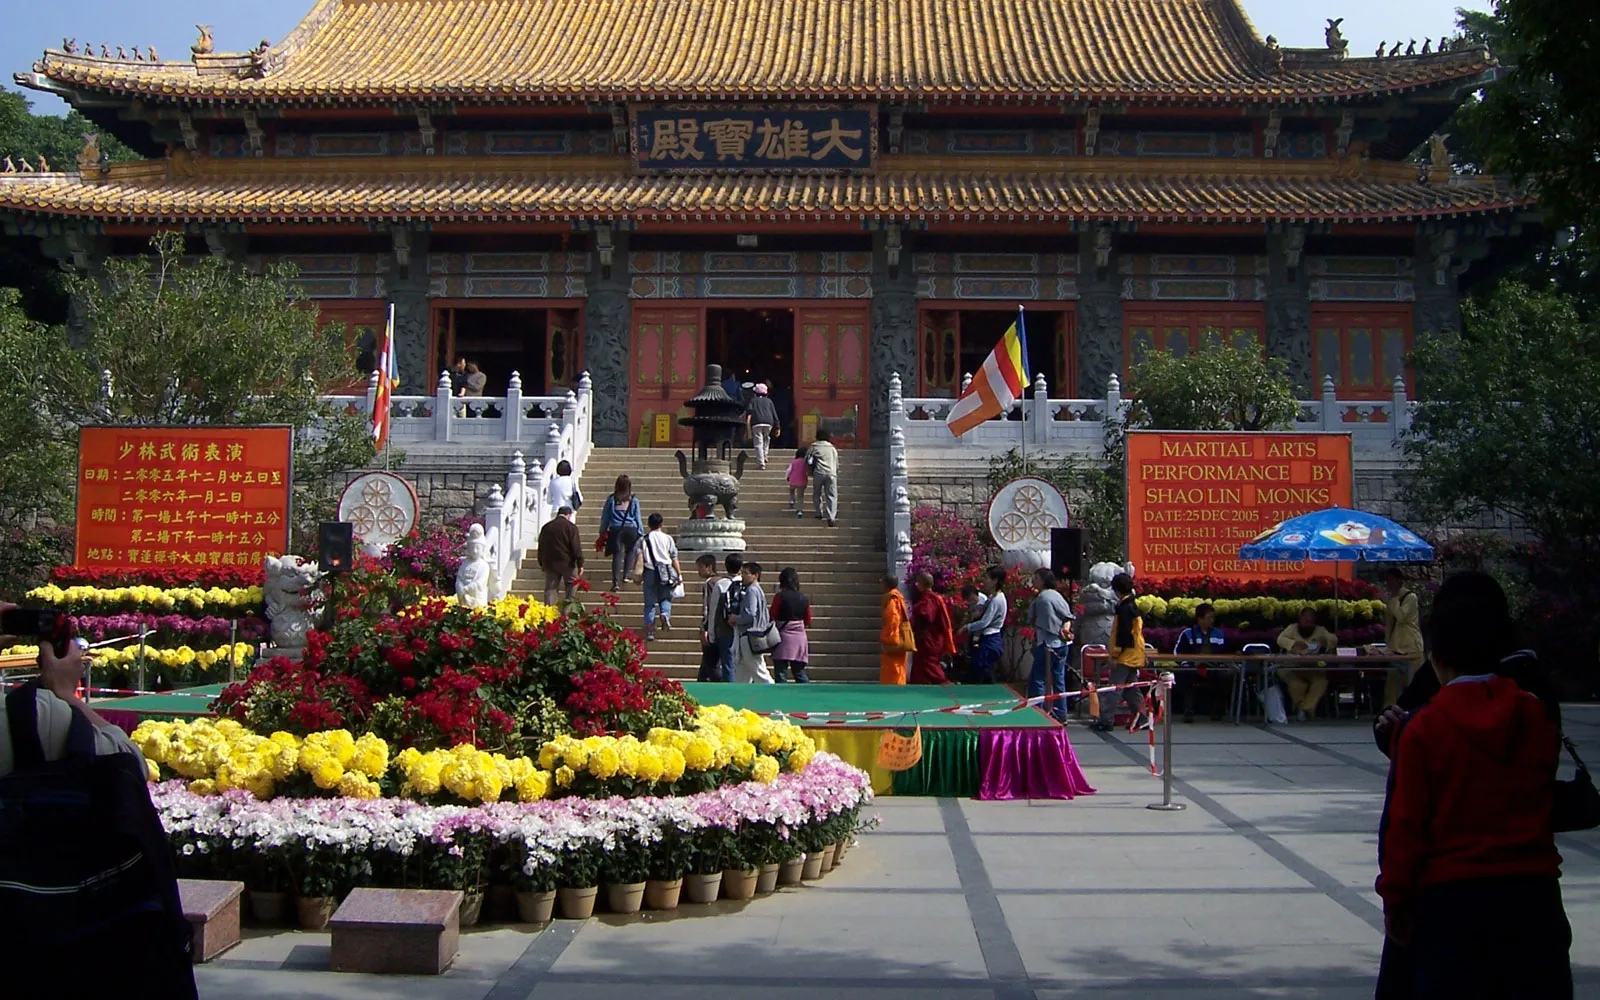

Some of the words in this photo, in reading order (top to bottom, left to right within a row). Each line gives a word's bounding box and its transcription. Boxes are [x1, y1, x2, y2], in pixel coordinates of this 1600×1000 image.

[119, 441, 244, 461] 少林武術表演
[1162, 441, 1253, 457] MARTIAL
[1267, 442, 1316, 458] ARTS
[1142, 464, 1289, 481] PERFORMANCE
[1312, 465, 1336, 481] BY
[122, 489, 242, 504] 二零零六年一月二日
[1146, 487, 1240, 504] SHAOLIN
[1256, 488, 1330, 504] MONKS
[131, 529, 265, 545] 第二場下午一時十五分
[1145, 560, 1184, 571] HALL
[1189, 560, 1208, 571] OF
[1213, 560, 1260, 572] GREAT
[1266, 560, 1305, 572] HERO
